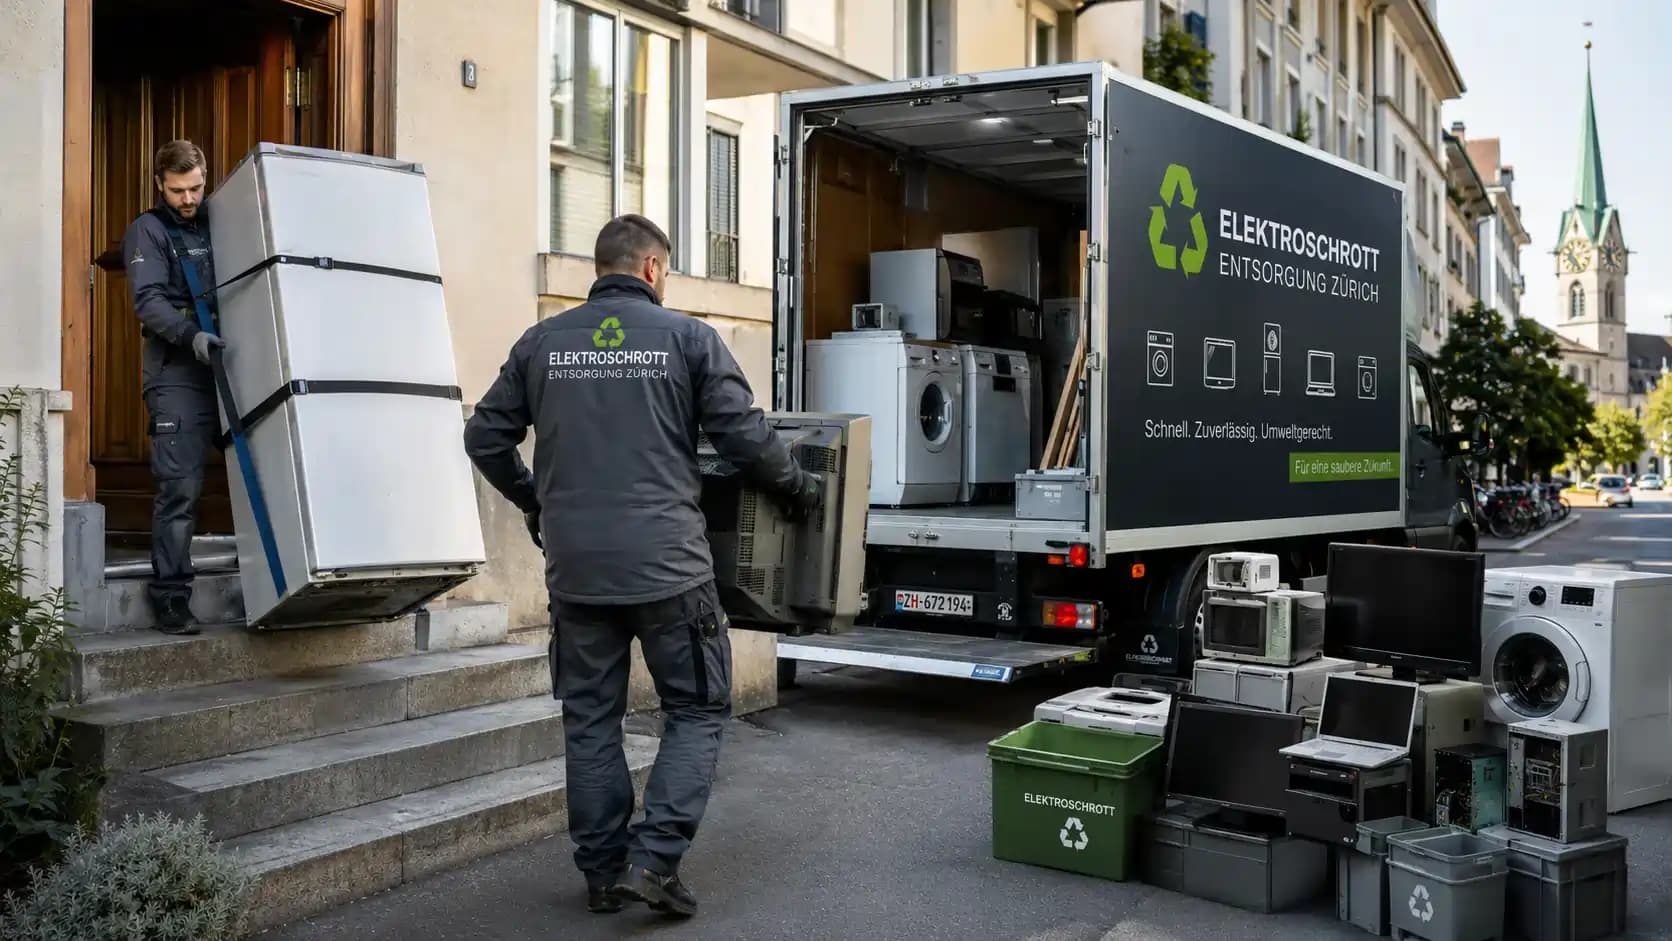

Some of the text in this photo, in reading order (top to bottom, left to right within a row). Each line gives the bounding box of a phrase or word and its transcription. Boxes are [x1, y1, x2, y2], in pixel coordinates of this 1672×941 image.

[1219, 208, 1380, 273] ELEKTROSCHROTT
[1219, 252, 1379, 303] ENTSORGUNG ZÜRICH
[549, 351, 669, 366] ELEKTROSCHROTT
[548, 367, 668, 380] ENTSORGUNG ZÜRICH
[1144, 419, 1333, 443] Schnell. Zuverlässig. Umweltgerecht.
[1295, 459, 1310, 475] Für
[1311, 459, 1329, 474] eine
[1330, 459, 1362, 473] saubere
[1024, 792, 1116, 817] ELEKTROSCHROTT
